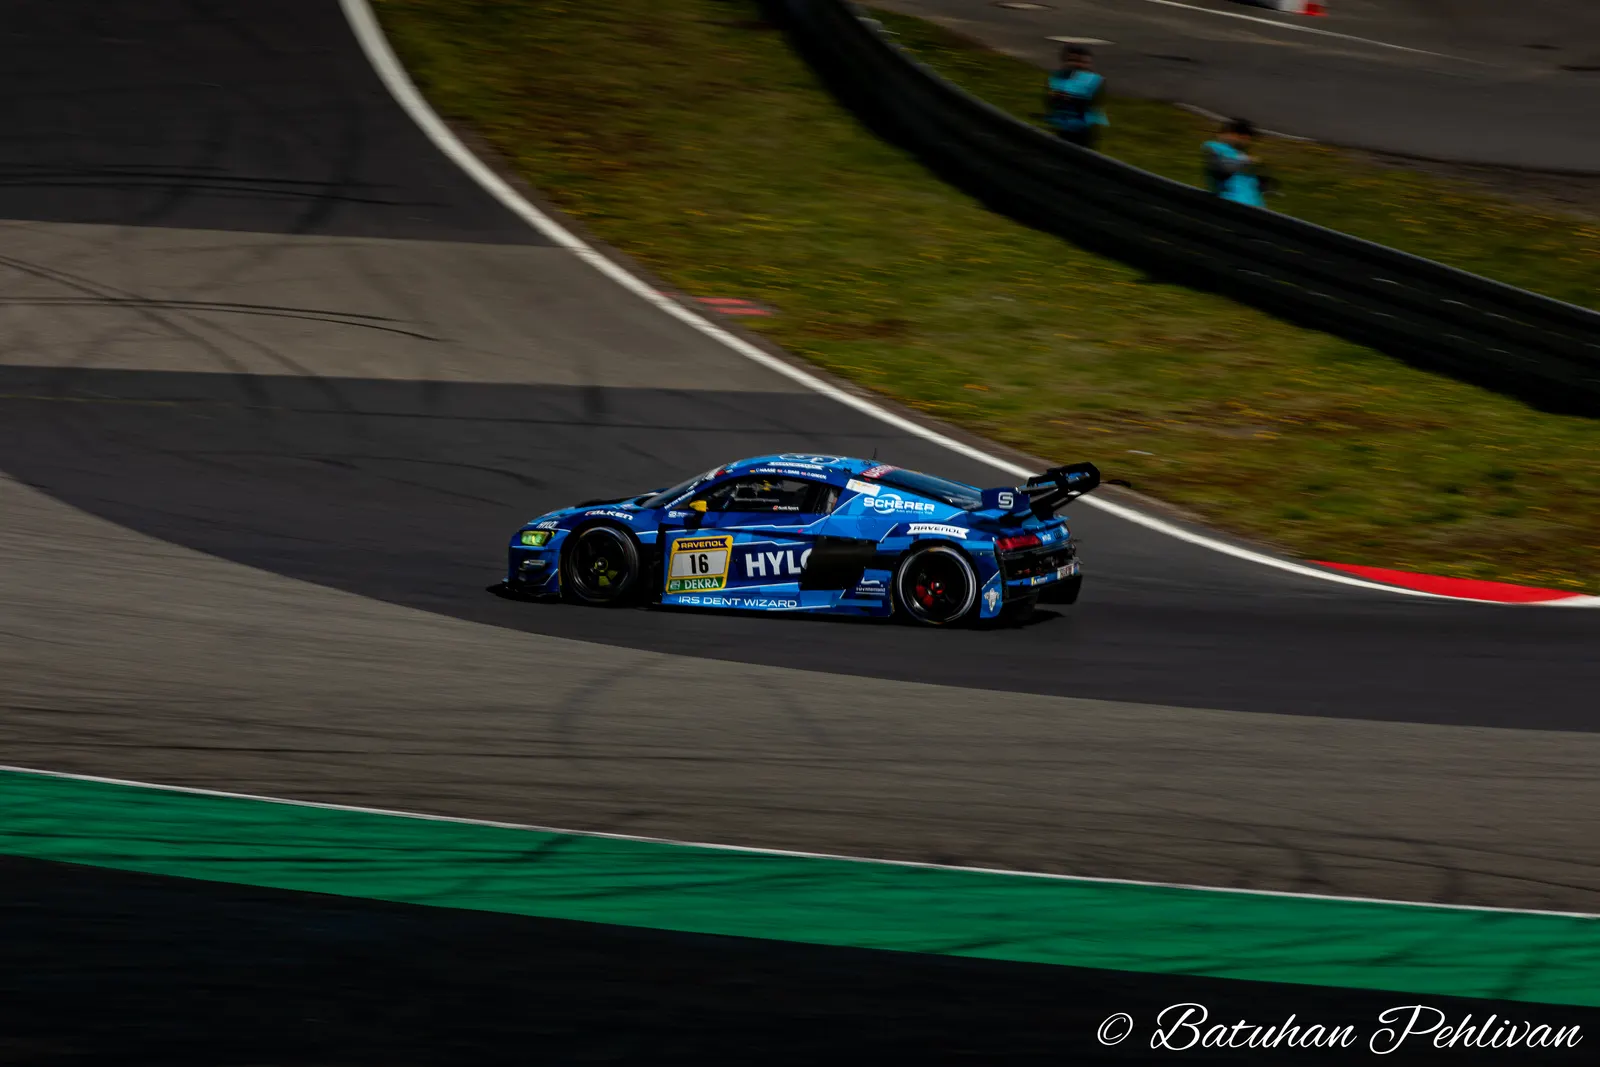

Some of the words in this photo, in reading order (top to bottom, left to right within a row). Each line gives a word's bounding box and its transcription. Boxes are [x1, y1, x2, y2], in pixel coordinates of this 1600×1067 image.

[863, 496, 935, 513] SCHERER
[584, 509, 634, 521] FALKEN
[680, 540, 724, 550] RAVENOL
[689, 554, 709, 574] 16
[684, 577, 719, 590] DEKRA
[678, 595, 700, 604] IRS
[702, 596, 741, 606] DENT
[743, 598, 798, 609] WIZARD
